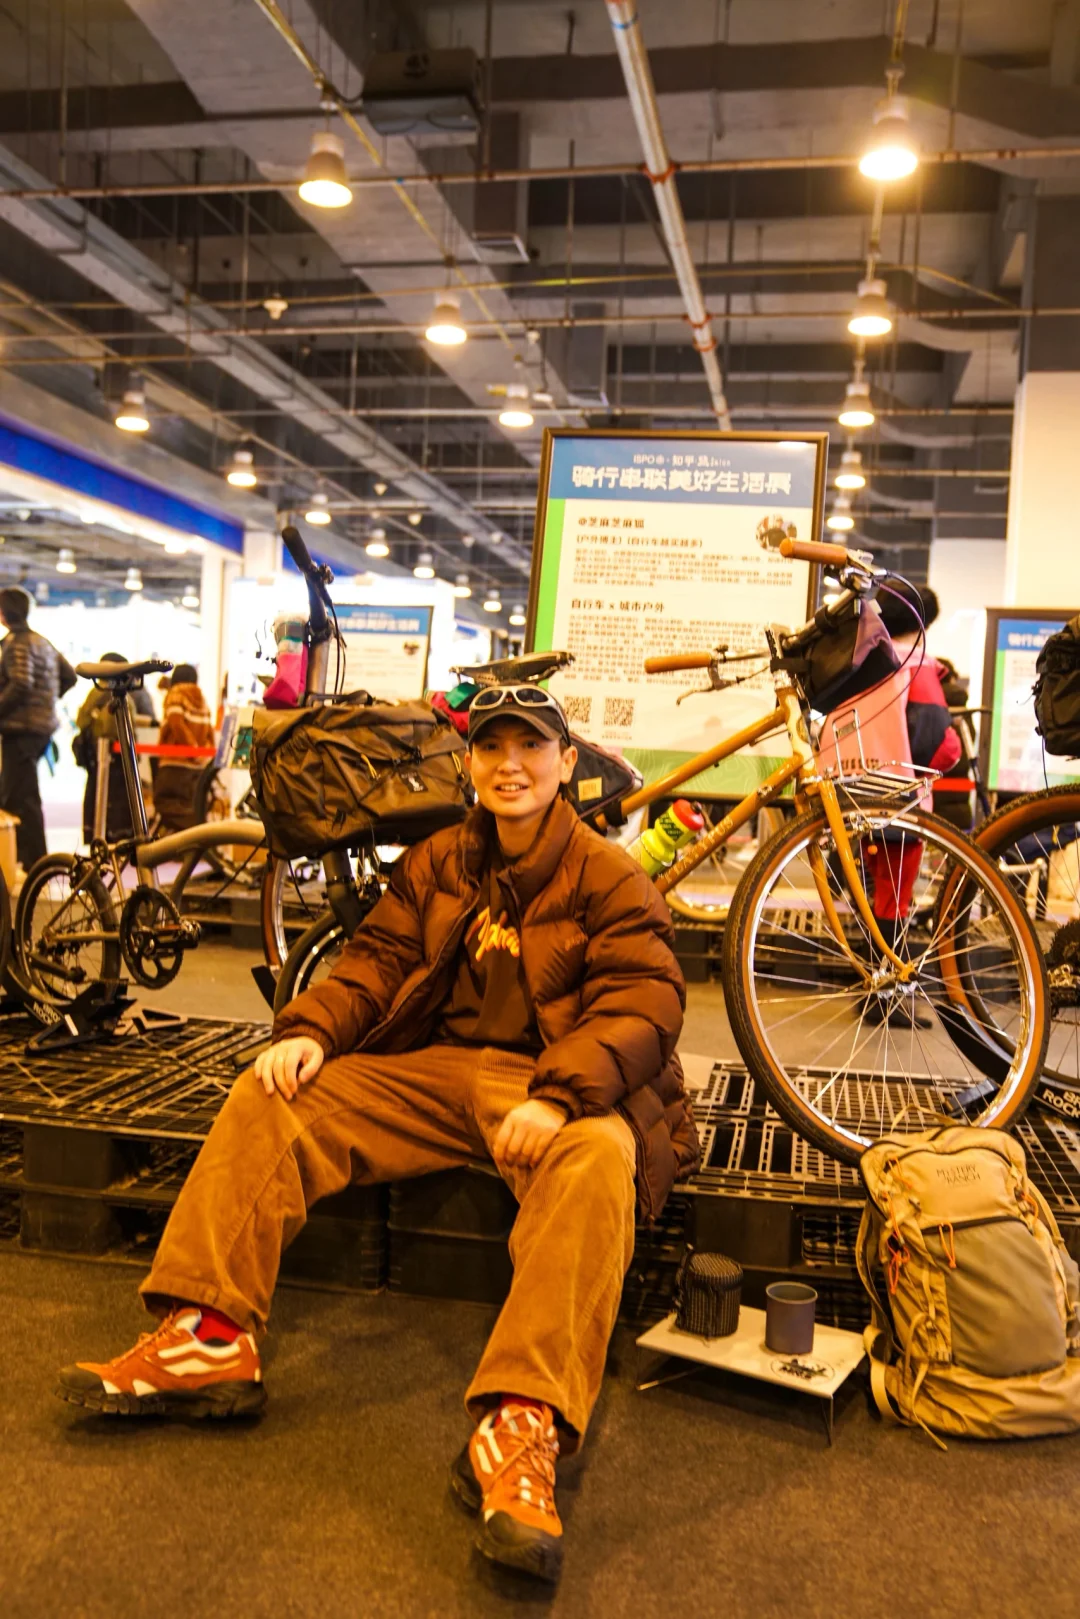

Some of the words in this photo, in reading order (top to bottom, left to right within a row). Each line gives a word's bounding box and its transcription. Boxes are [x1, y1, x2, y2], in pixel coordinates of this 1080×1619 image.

[571, 599, 604, 610] 自行车
[619, 601, 665, 612] 城市户外
